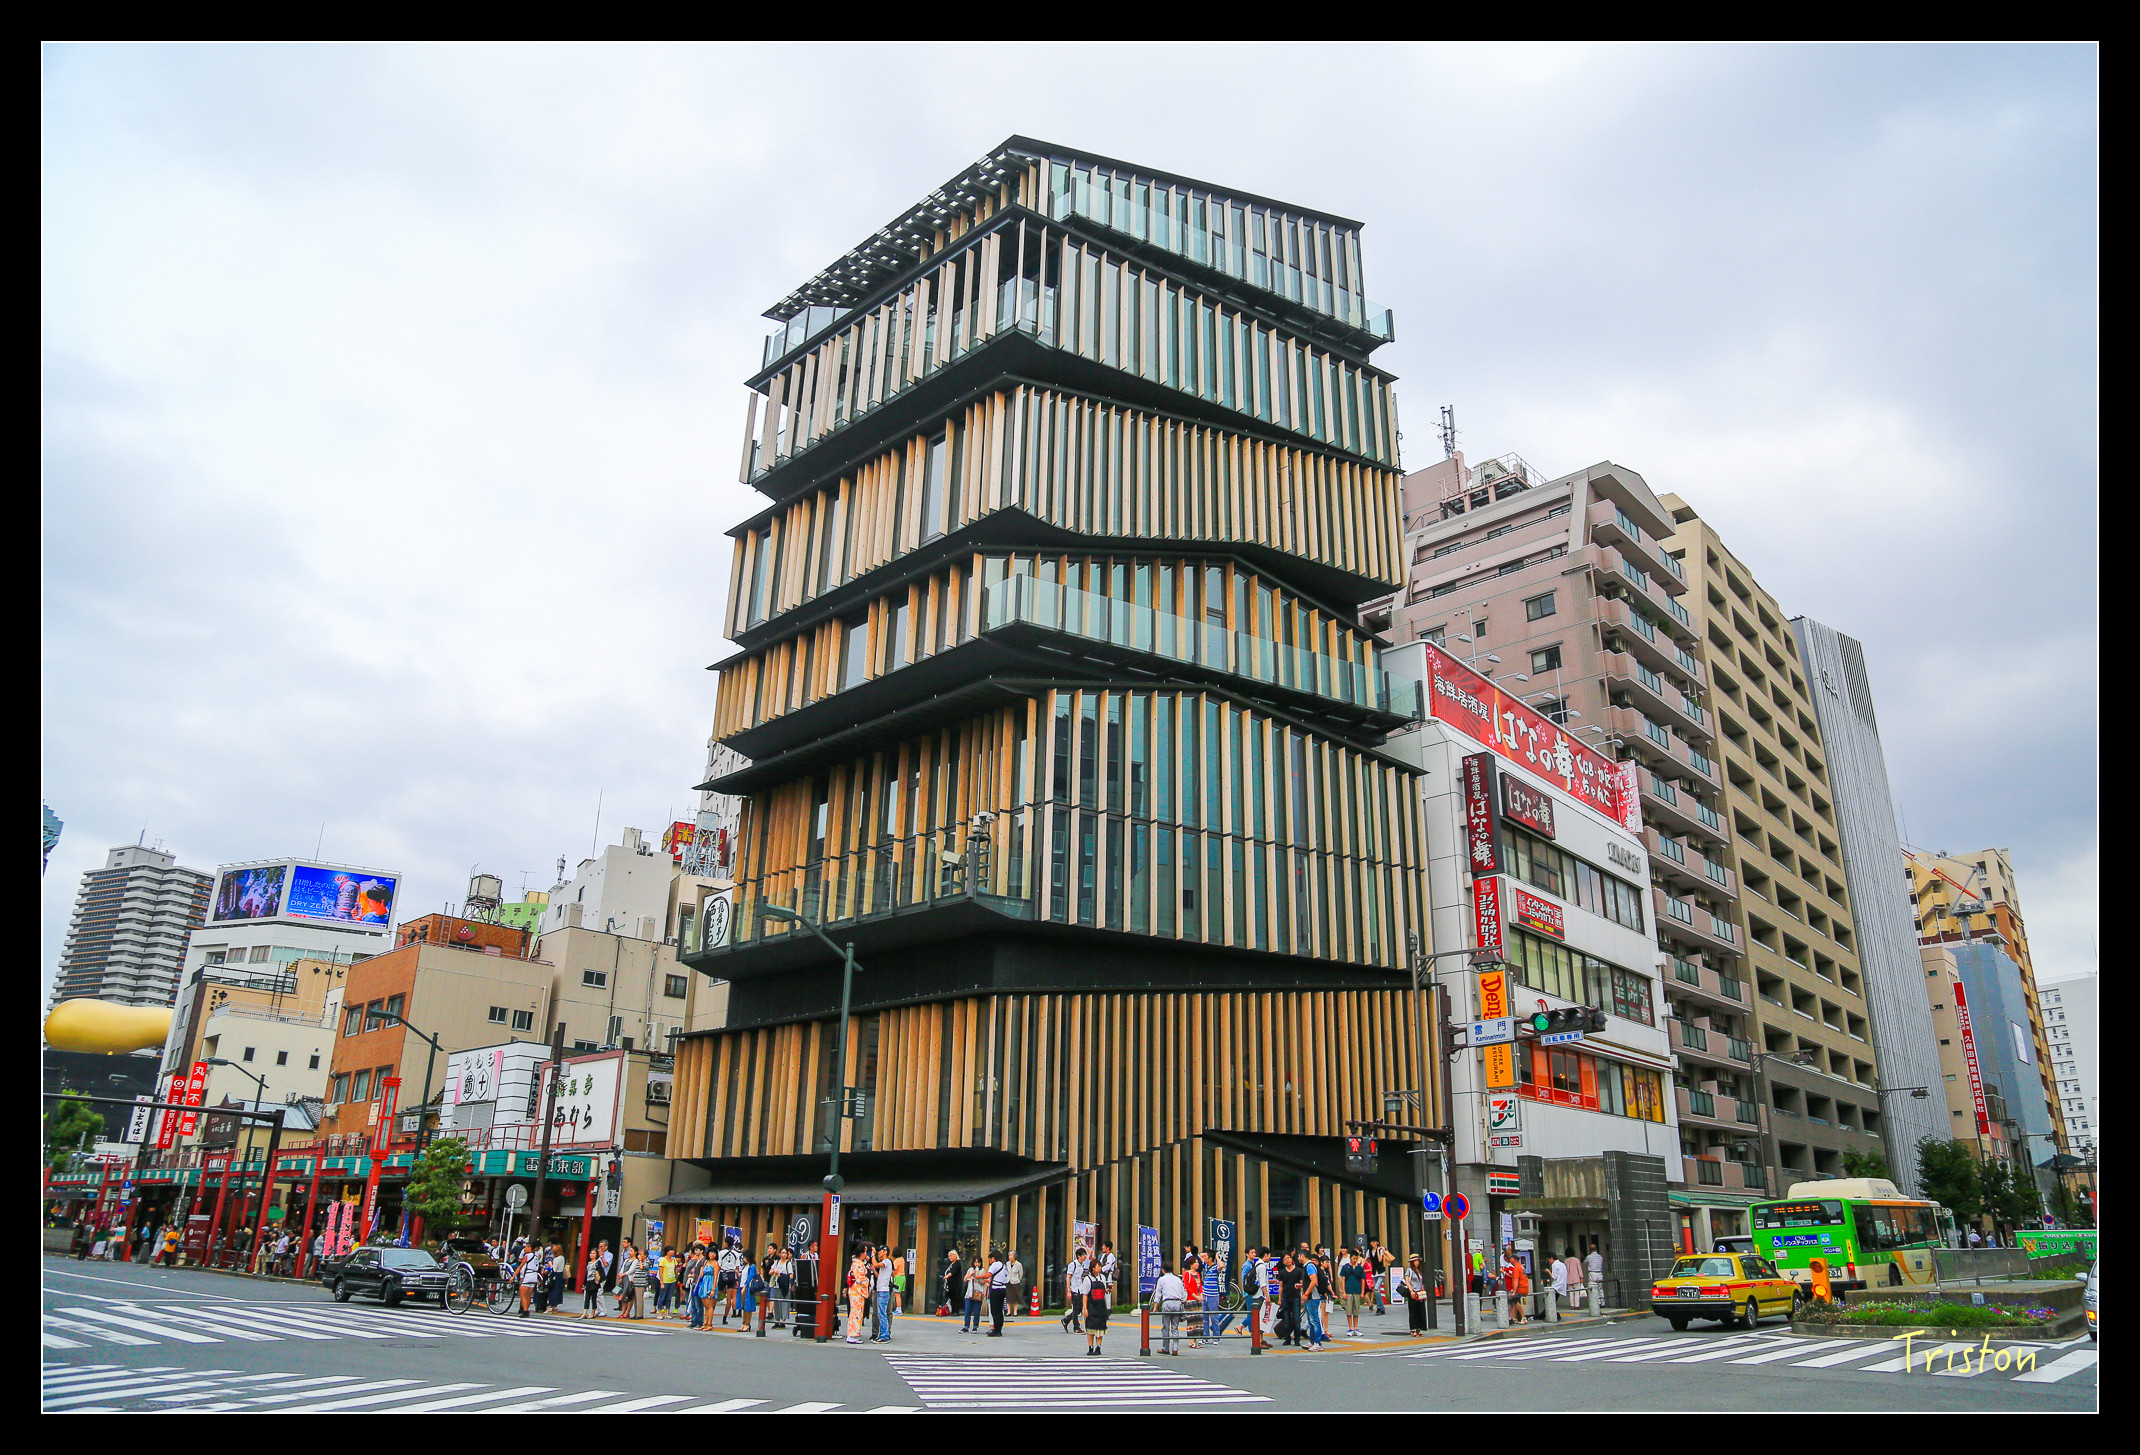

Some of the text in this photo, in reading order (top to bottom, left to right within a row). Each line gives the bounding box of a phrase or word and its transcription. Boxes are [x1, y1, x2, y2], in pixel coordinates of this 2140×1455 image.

[1434, 673, 1575, 791] 海鮮居酒屋 はなの舞
[1470, 758, 1482, 800] 海鮮居酒屋
[1508, 785, 1552, 832] はなの舞
[1470, 800, 1492, 867] はなの舞
[290, 900, 334, 911] DRY ZERO
[1478, 894, 1490, 947] コミックカフェ
[216, 989, 228, 1004] 中
[1474, 1020, 1507, 1036] 雷門
[1475, 1033, 1506, 1042] Kaminarimon
[1491, 1045, 1500, 1084] ESTAURANT
[162, 1095, 179, 1145] 三京UFJ銀行
[180, 1065, 206, 1133] 丸勝不動産
[1151, 1235, 1162, 1279] 外貨両替
[2037, 1240, 2095, 1251] 振り込詐
